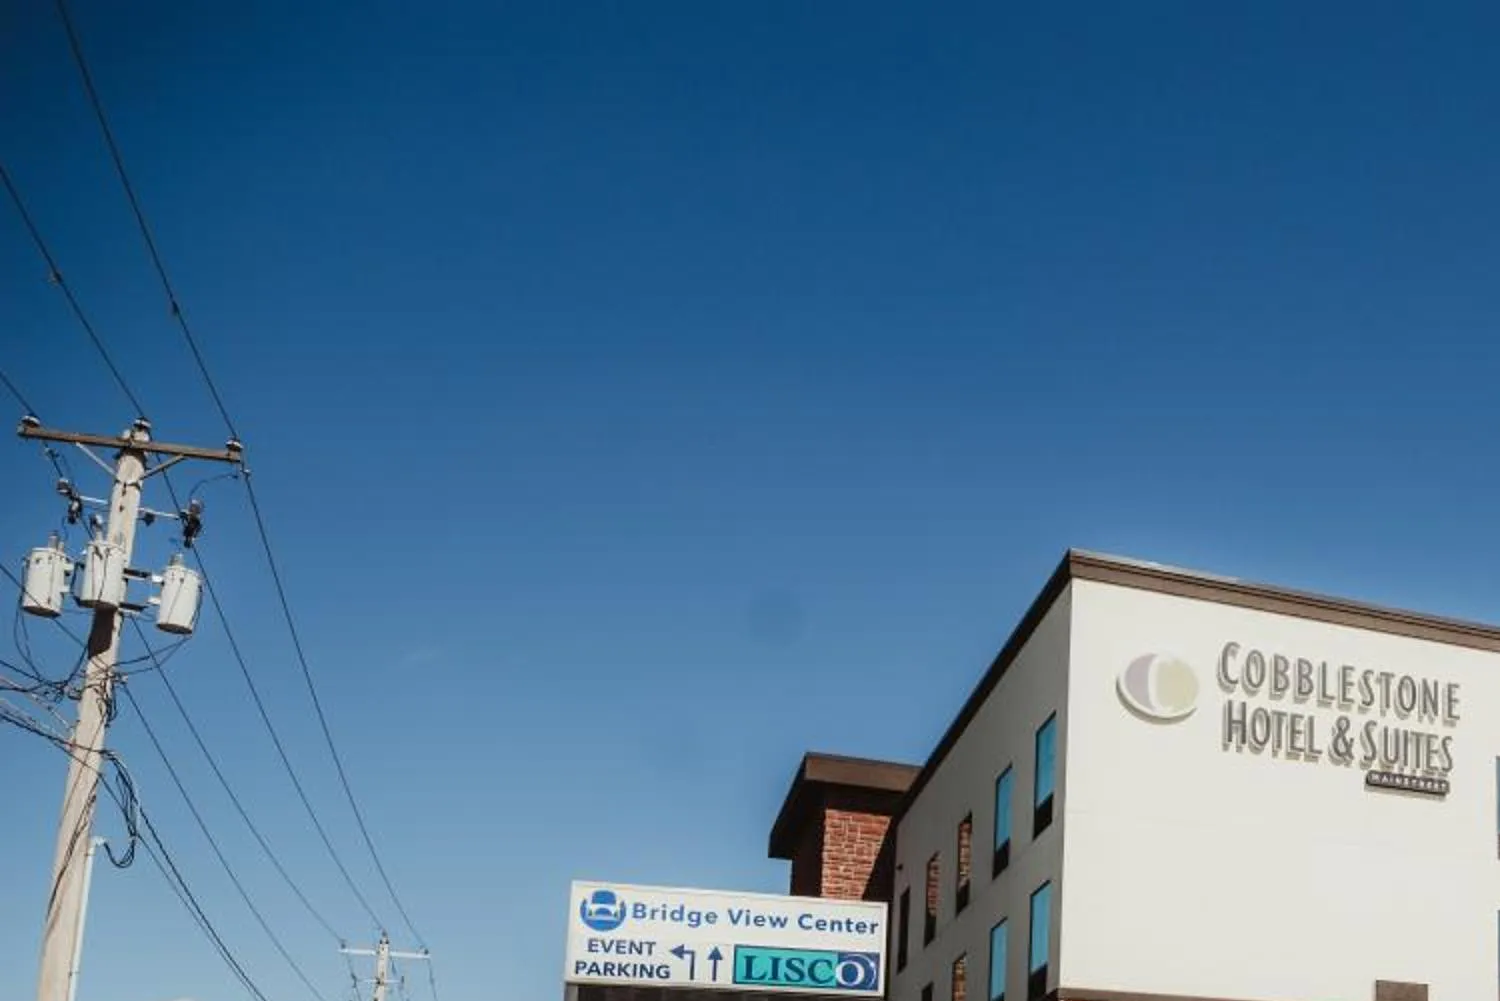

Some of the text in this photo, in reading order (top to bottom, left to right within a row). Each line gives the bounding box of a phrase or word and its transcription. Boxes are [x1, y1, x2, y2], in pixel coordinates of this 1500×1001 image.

[1218, 640, 1461, 724] COBBLESTONE
[1222, 700, 1455, 774] HOTEL & SUITES
[631, 902, 880, 935] Bridge View Center
[587, 937, 657, 957] EVENT
[574, 960, 672, 980] PARKING
[743, 953, 868, 988] LISCO
